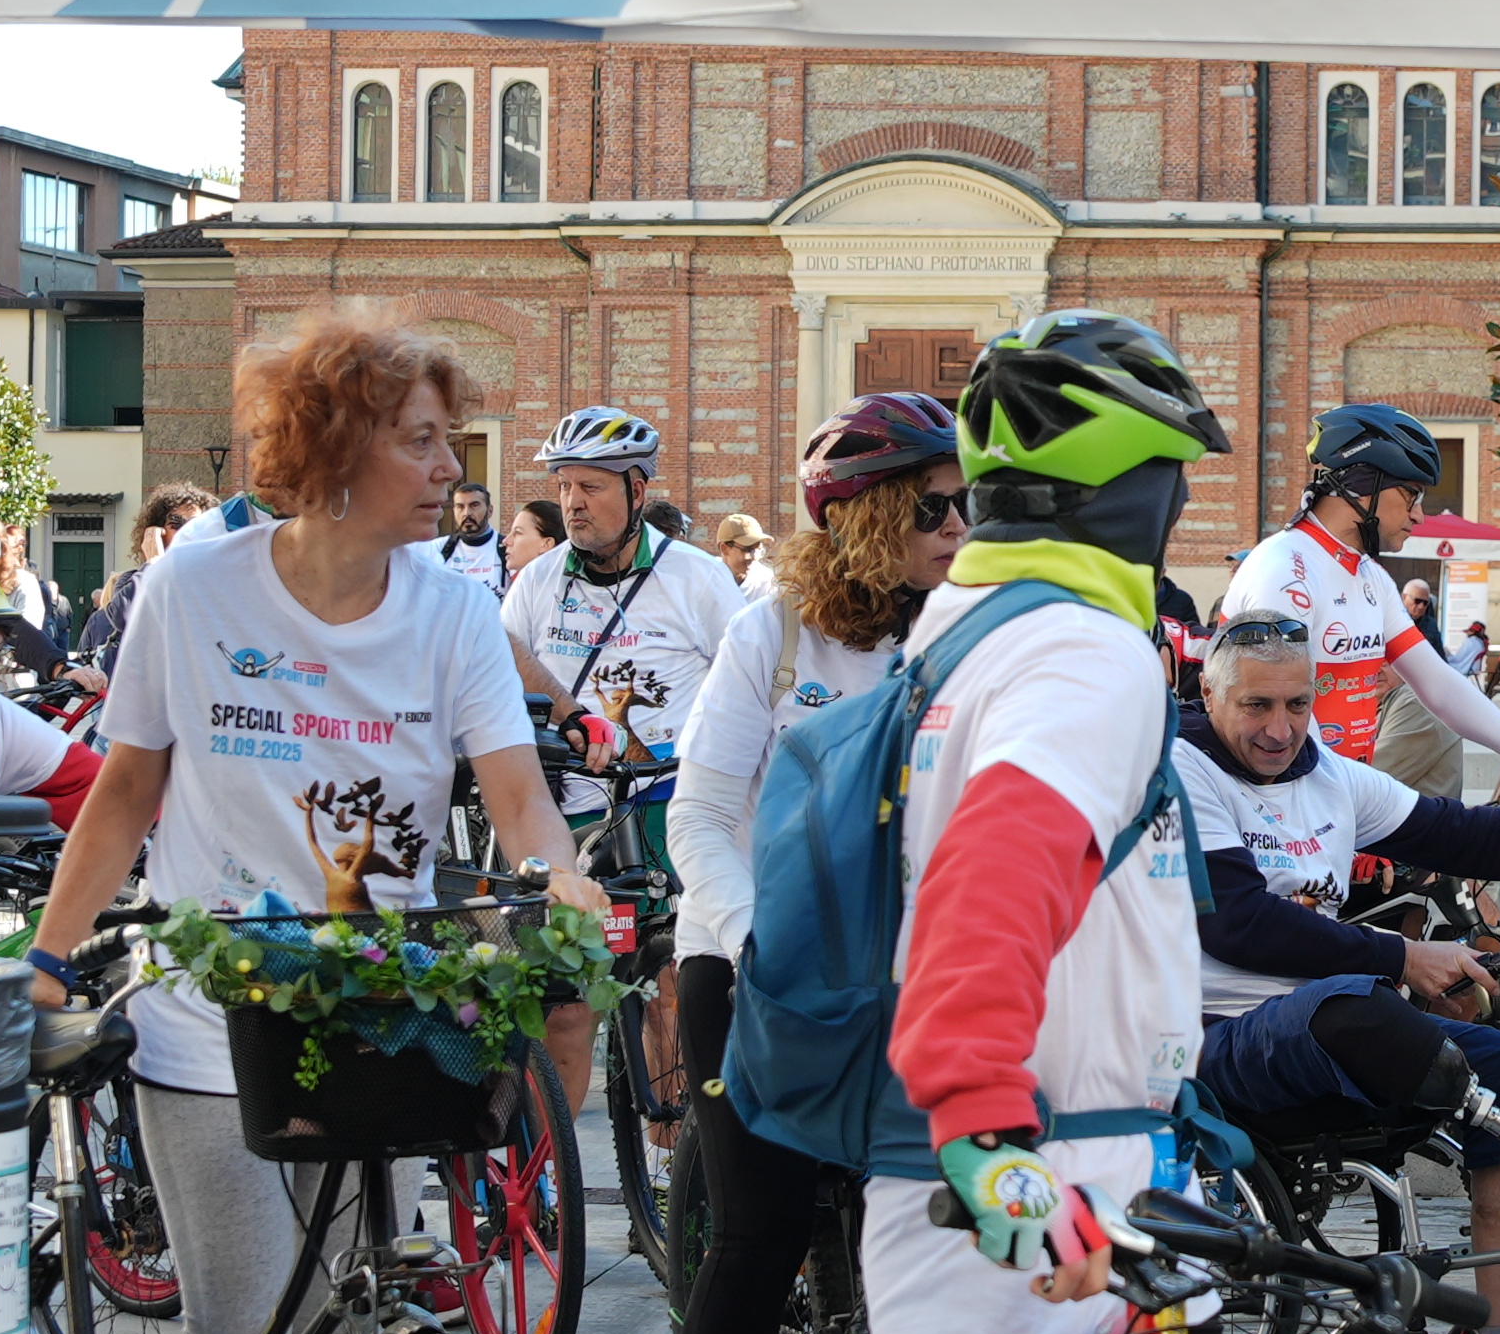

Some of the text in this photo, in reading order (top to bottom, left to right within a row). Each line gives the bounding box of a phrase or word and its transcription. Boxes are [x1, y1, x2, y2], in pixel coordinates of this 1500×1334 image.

[806, 255, 1032, 271] DIVO STEPHANO PROTOMARTIRI
[1332, 632, 1386, 654] FIORA
[272, 667, 328, 688] SPORT DAY
[211, 703, 286, 734] SPECIAL
[292, 712, 352, 741] SPORT
[357, 720, 396, 745] DAY
[210, 734, 303, 763] 28.09.2025
